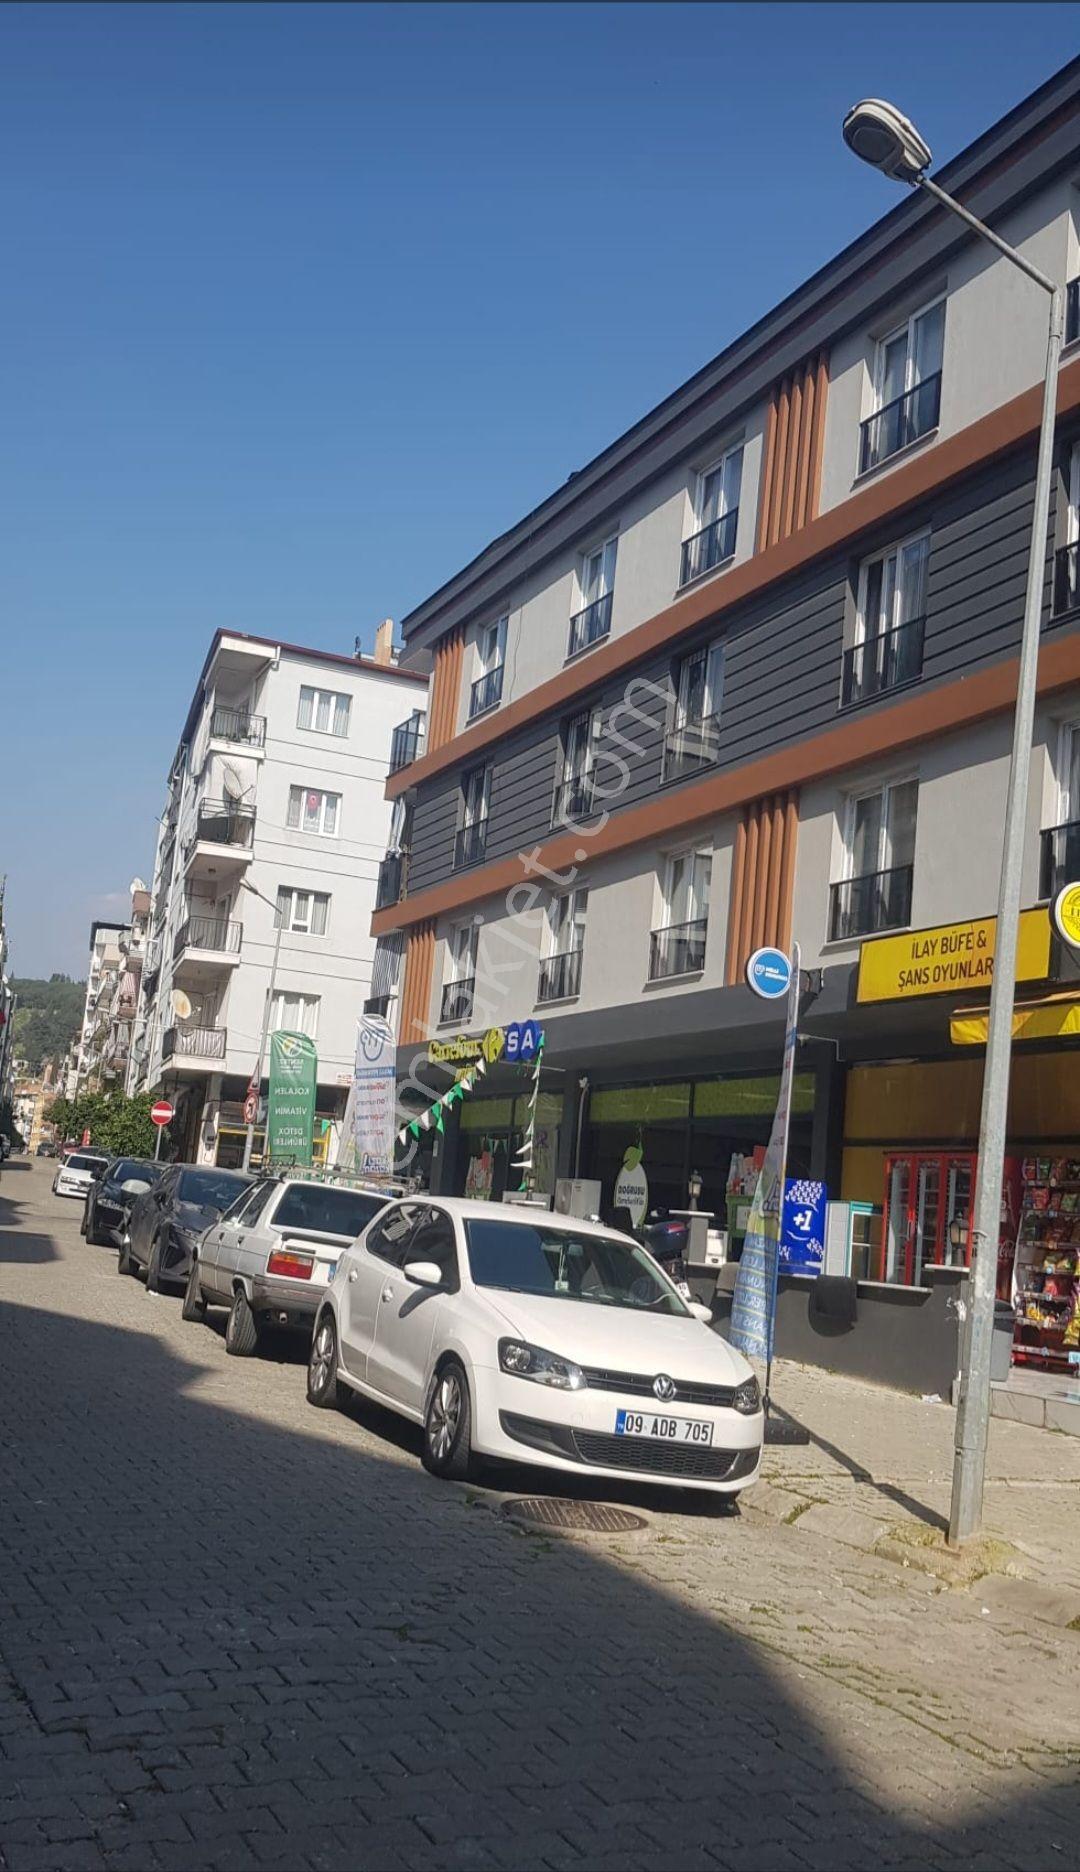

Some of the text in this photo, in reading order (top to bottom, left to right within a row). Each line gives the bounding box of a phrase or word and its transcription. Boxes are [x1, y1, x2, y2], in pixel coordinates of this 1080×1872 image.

[910, 929, 987, 960] İLAY BÜFE &
[897, 956, 995, 993] ŞANS OYUNLAR
[506, 1029, 534, 1053] SA
[792, 1209, 813, 1231] +1
[625, 1414, 709, 1442] 09 ADB 705
